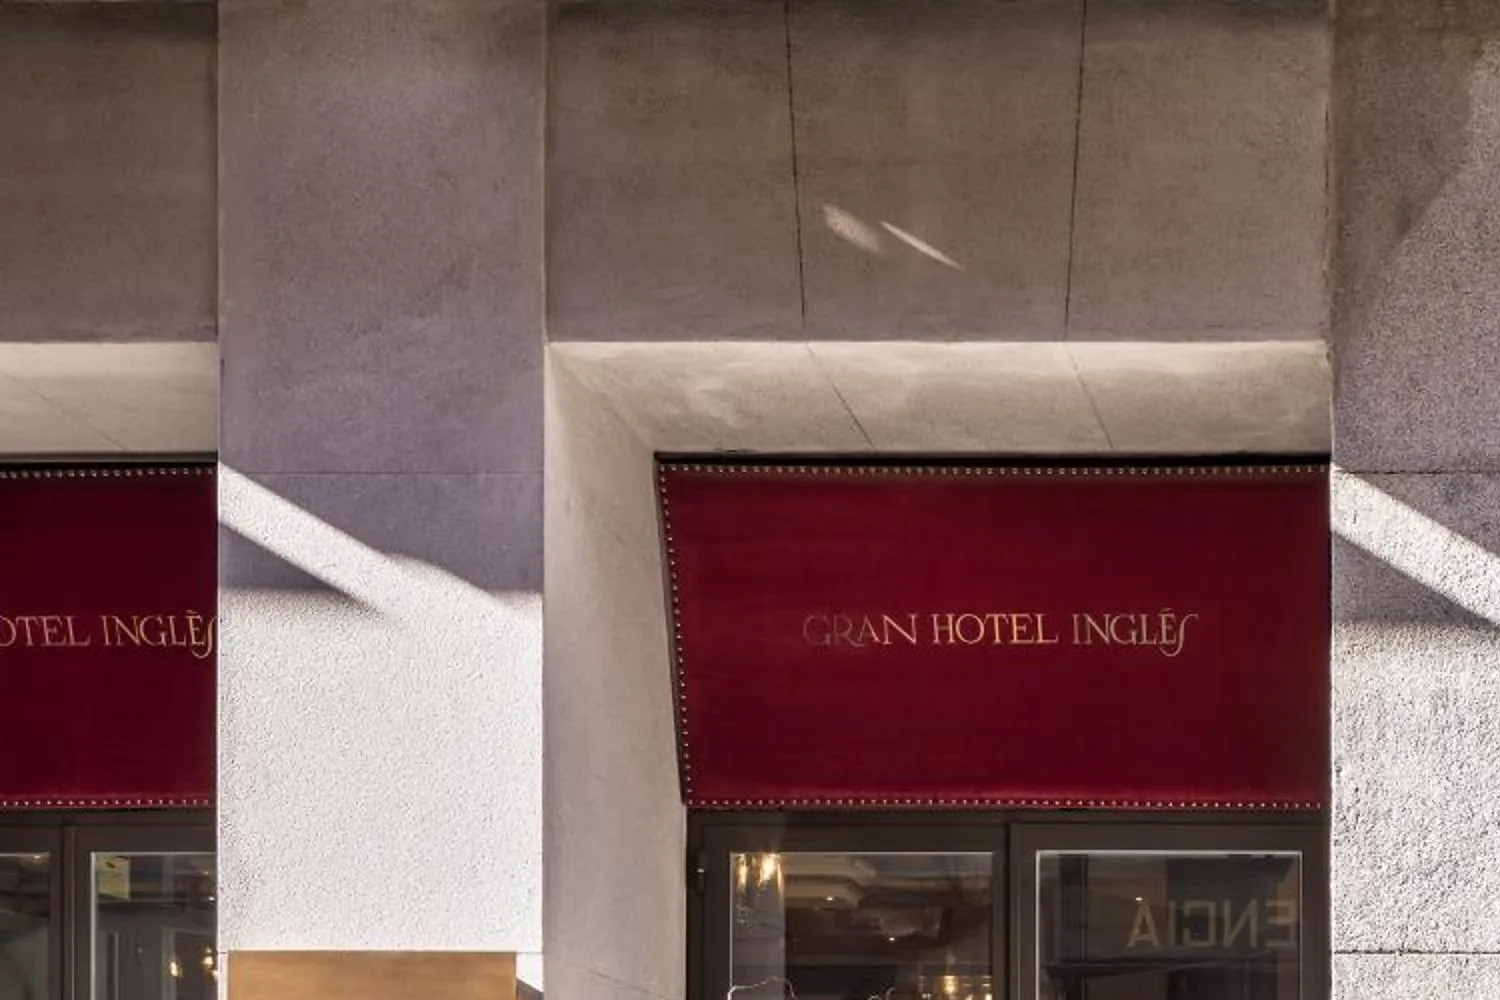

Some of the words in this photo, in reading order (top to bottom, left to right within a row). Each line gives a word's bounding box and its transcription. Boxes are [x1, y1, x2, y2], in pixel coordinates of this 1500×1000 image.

[100, 609, 218, 660] INGLÉS
[802, 612, 918, 649] GRAN
[932, 612, 1060, 646] HOTEL
[1071, 607, 1199, 657] INGLÉS
